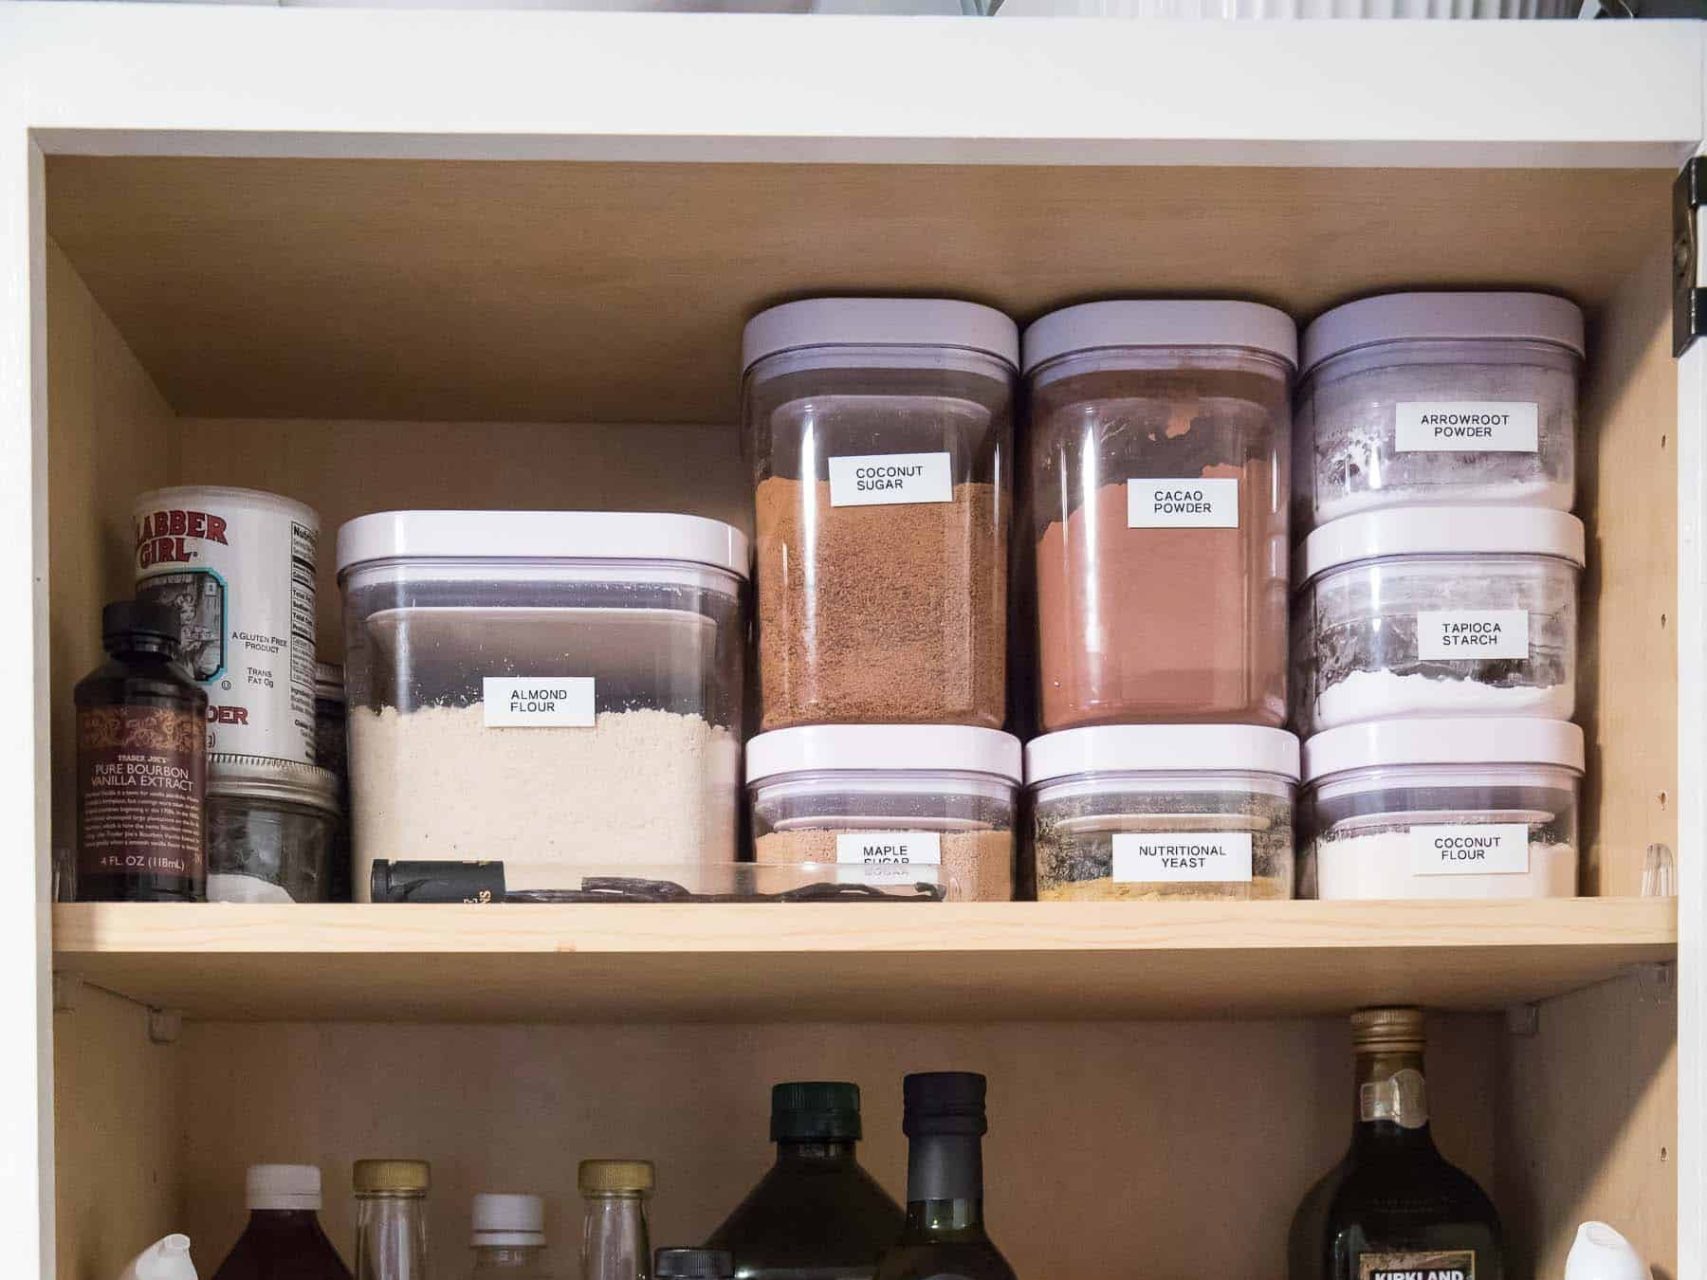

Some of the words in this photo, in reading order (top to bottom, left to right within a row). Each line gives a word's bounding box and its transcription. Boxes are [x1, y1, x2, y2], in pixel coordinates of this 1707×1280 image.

[1420, 413, 1510, 427] ARROWROOT
[1434, 425, 1493, 438] POWDER
[855, 466, 924, 480] COCONUT
[856, 477, 905, 491] SUGAR
[1153, 490, 1204, 502] CACAO
[1153, 502, 1213, 515] POWDER
[139, 537, 193, 569] GIRL
[1442, 622, 1502, 634] TAPIOCA
[240, 632, 270, 642] GLUTEN
[1442, 633, 1499, 646] STARCH
[245, 642, 279, 653] PRODUCT
[247, 667, 272, 677] TRANS
[247, 676, 262, 685] FAT
[510, 689, 567, 701] ALMOND
[510, 701, 555, 713] FLOUR
[95, 764, 124, 774] PURE
[127, 764, 189, 779] BOURBON
[91, 775, 137, 786] VANILLA
[140, 776, 194, 791] EXTRACT
[1434, 836, 1501, 850] COCONUT
[863, 845, 908, 856] MAPLE
[1139, 845, 1227, 857] NUTRITIONAL
[1441, 849, 1486, 861] FLOUR
[125, 856, 145, 866] OZ
[1161, 857, 1207, 868] YEAST
